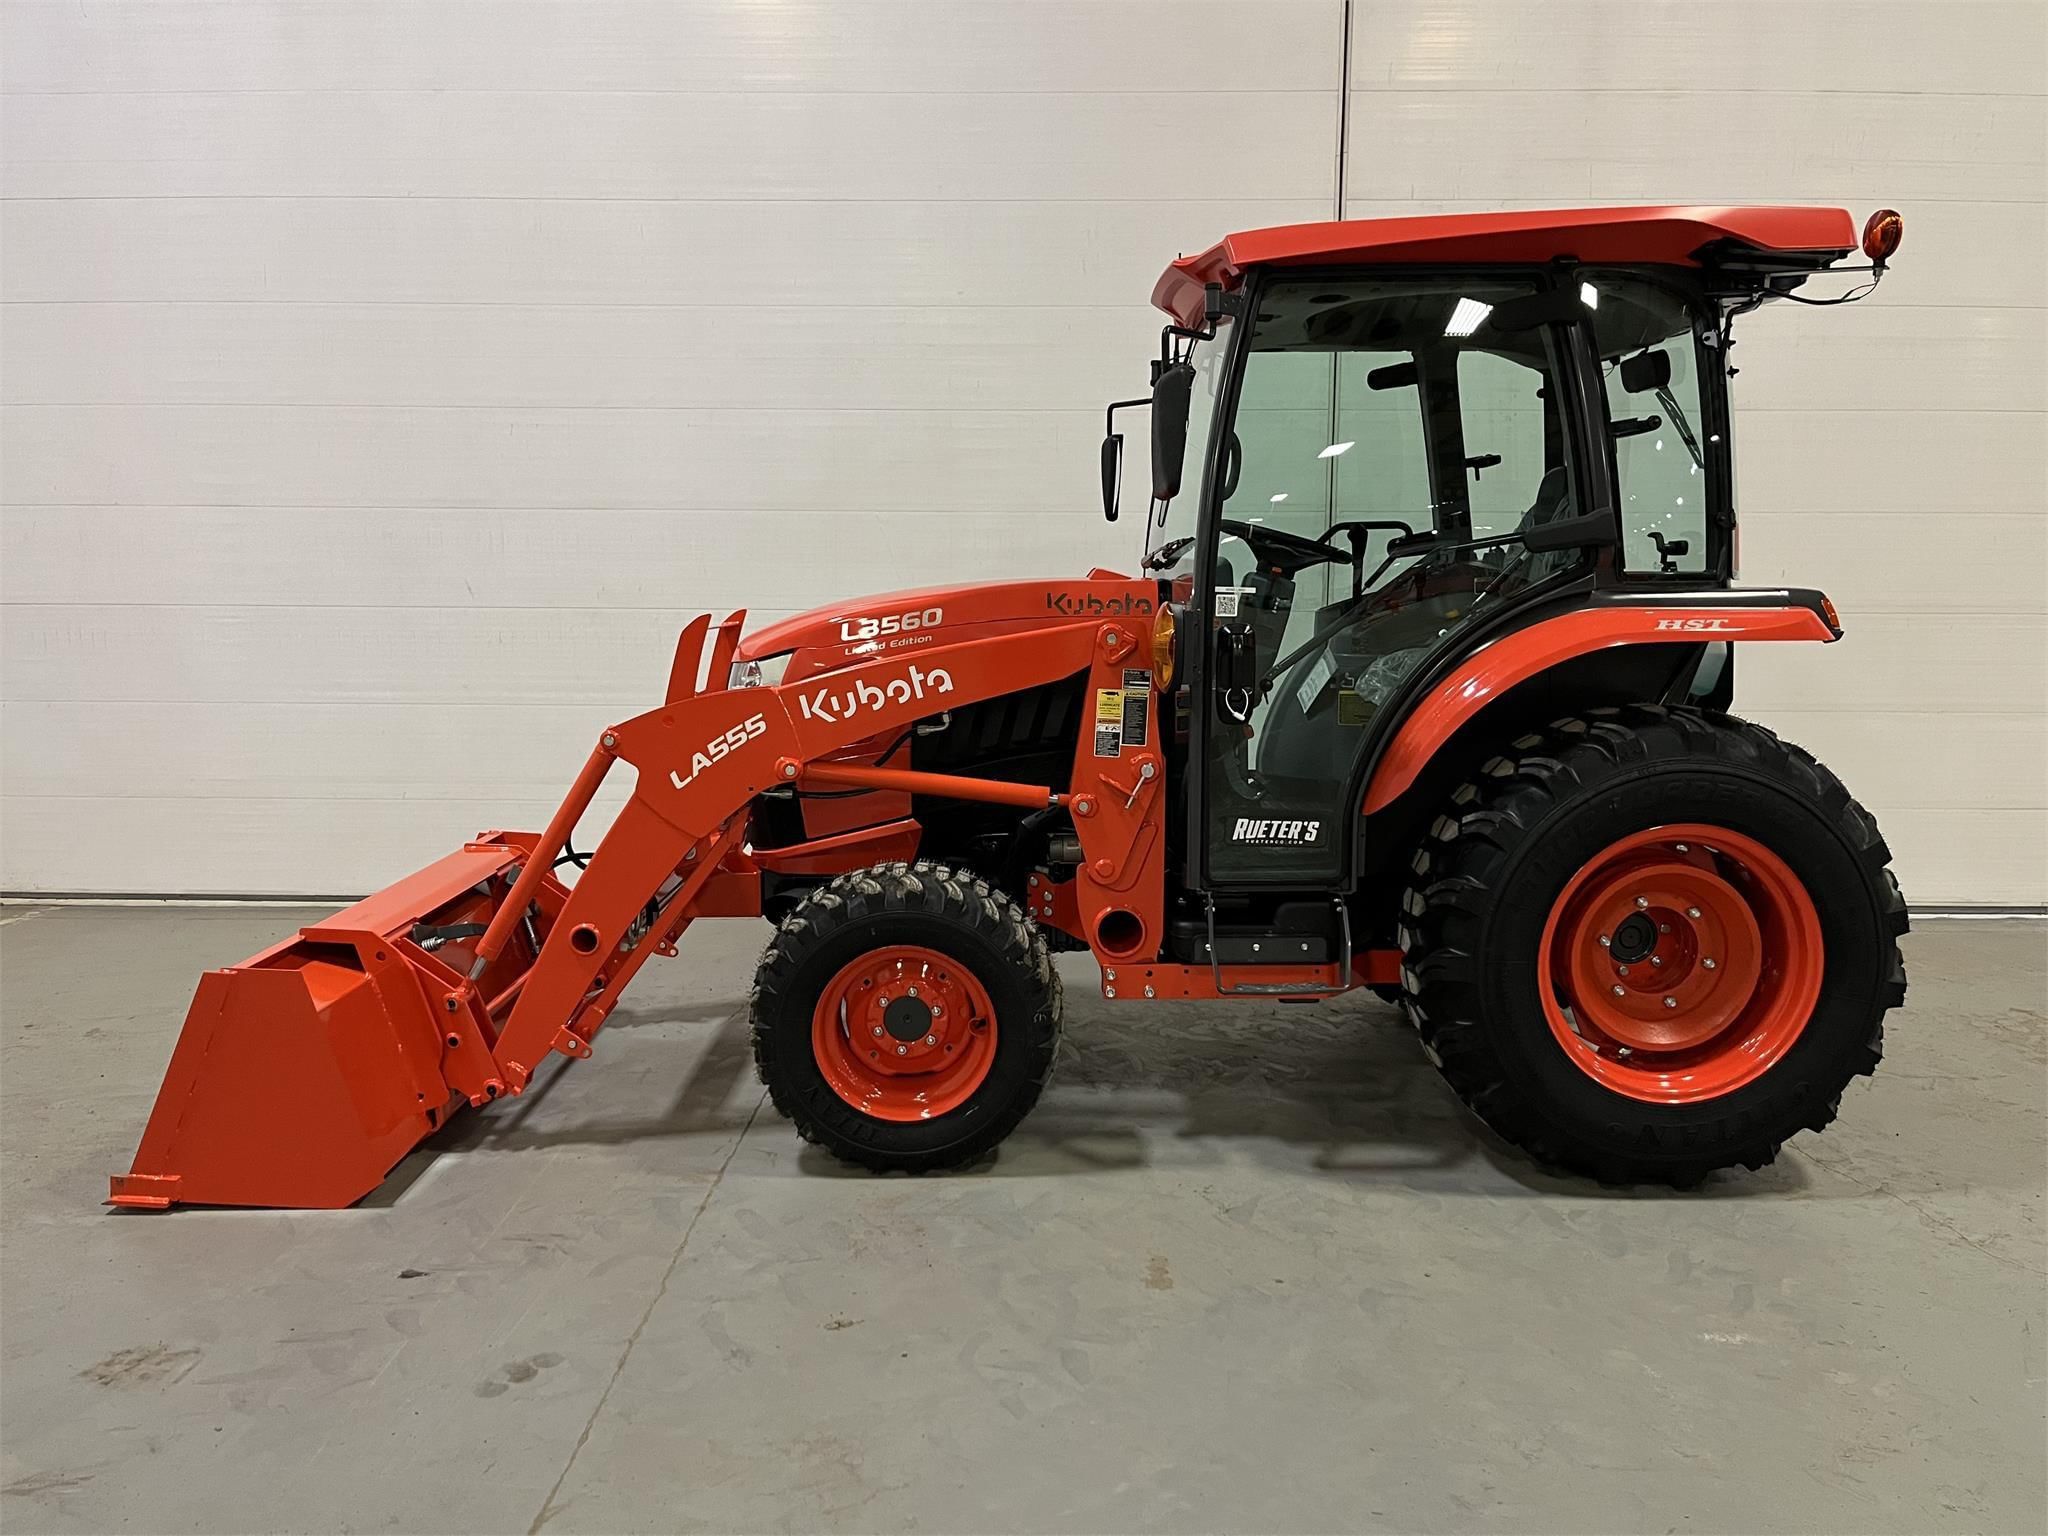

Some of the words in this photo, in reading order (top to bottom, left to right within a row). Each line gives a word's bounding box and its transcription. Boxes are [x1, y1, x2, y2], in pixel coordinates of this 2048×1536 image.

[1046, 592, 1153, 616] Kubota
[841, 607, 943, 641] L3560
[1654, 618, 1730, 632] HST
[844, 640, 886, 656] Lied
[889, 635, 933, 649] Edition
[798, 665, 954, 723] Kubota
[669, 712, 767, 790] LA555
[1232, 818, 1320, 842] RUETER'S
